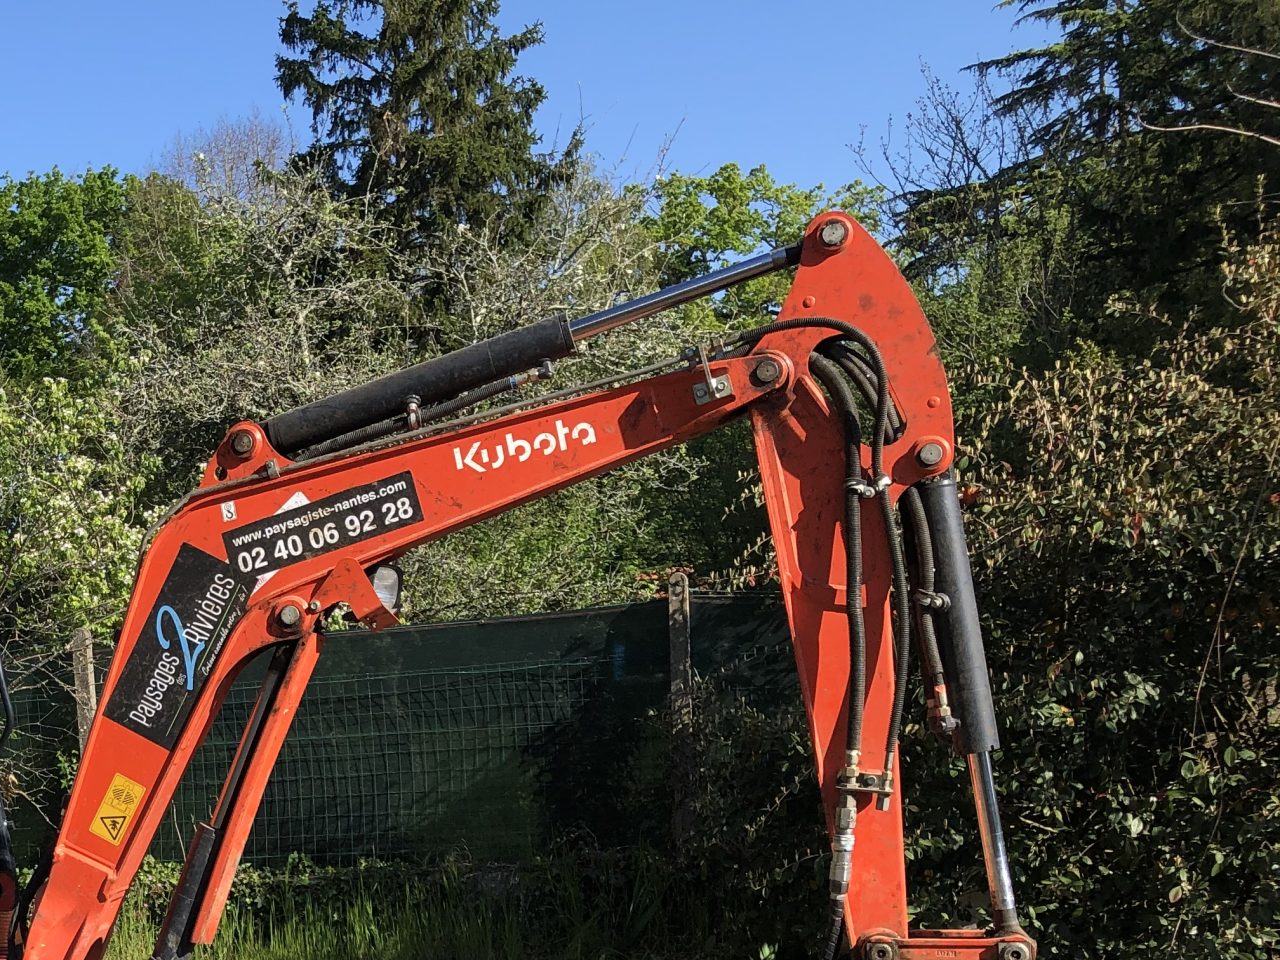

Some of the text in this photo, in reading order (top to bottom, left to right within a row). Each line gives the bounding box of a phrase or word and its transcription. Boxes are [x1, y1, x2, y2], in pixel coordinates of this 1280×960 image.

[453, 419, 597, 473] Kubota
[232, 480, 407, 547] www.paysagiste-nantes.com
[237, 497, 414, 574] 02 40 06 92 28
[182, 573, 235, 645] Rivières
[156, 605, 206, 691] 2
[129, 652, 180, 727] Paysages
